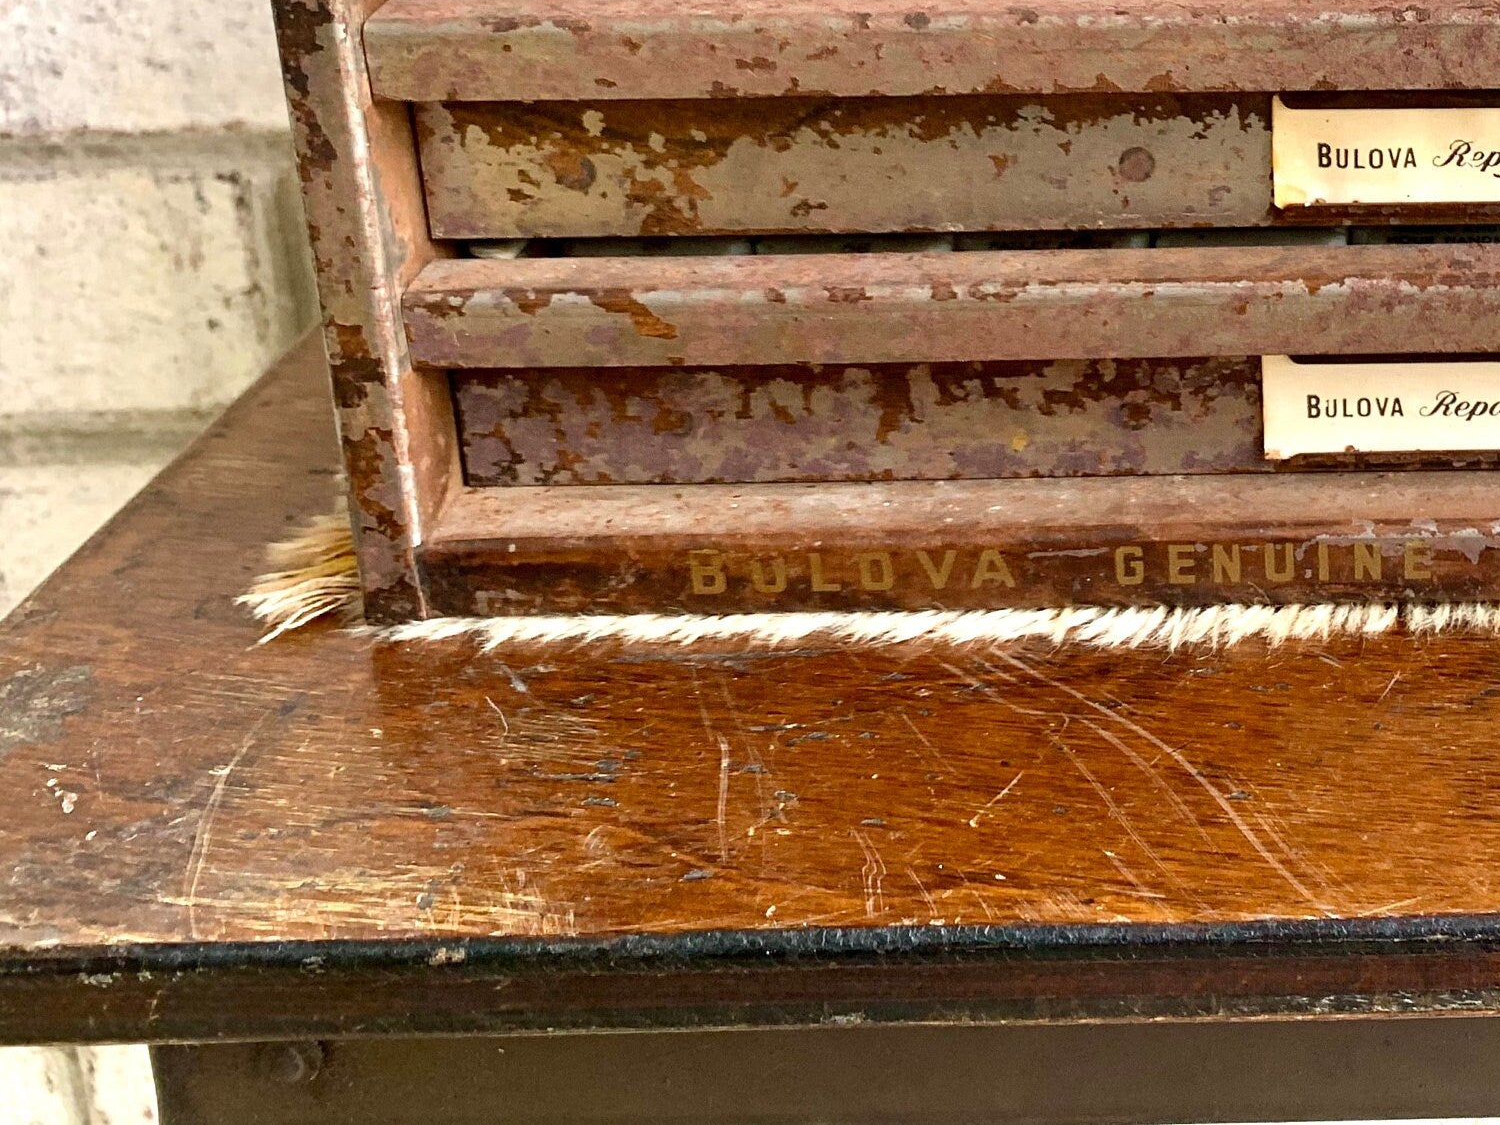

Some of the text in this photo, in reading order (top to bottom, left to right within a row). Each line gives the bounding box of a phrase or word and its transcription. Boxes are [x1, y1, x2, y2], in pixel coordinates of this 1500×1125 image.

[1317, 142, 1417, 168] BULOVA
[1306, 394, 1404, 419] BULOVA
[689, 547, 1016, 597] BULOVA
[1113, 542, 1434, 586] GENUINE
